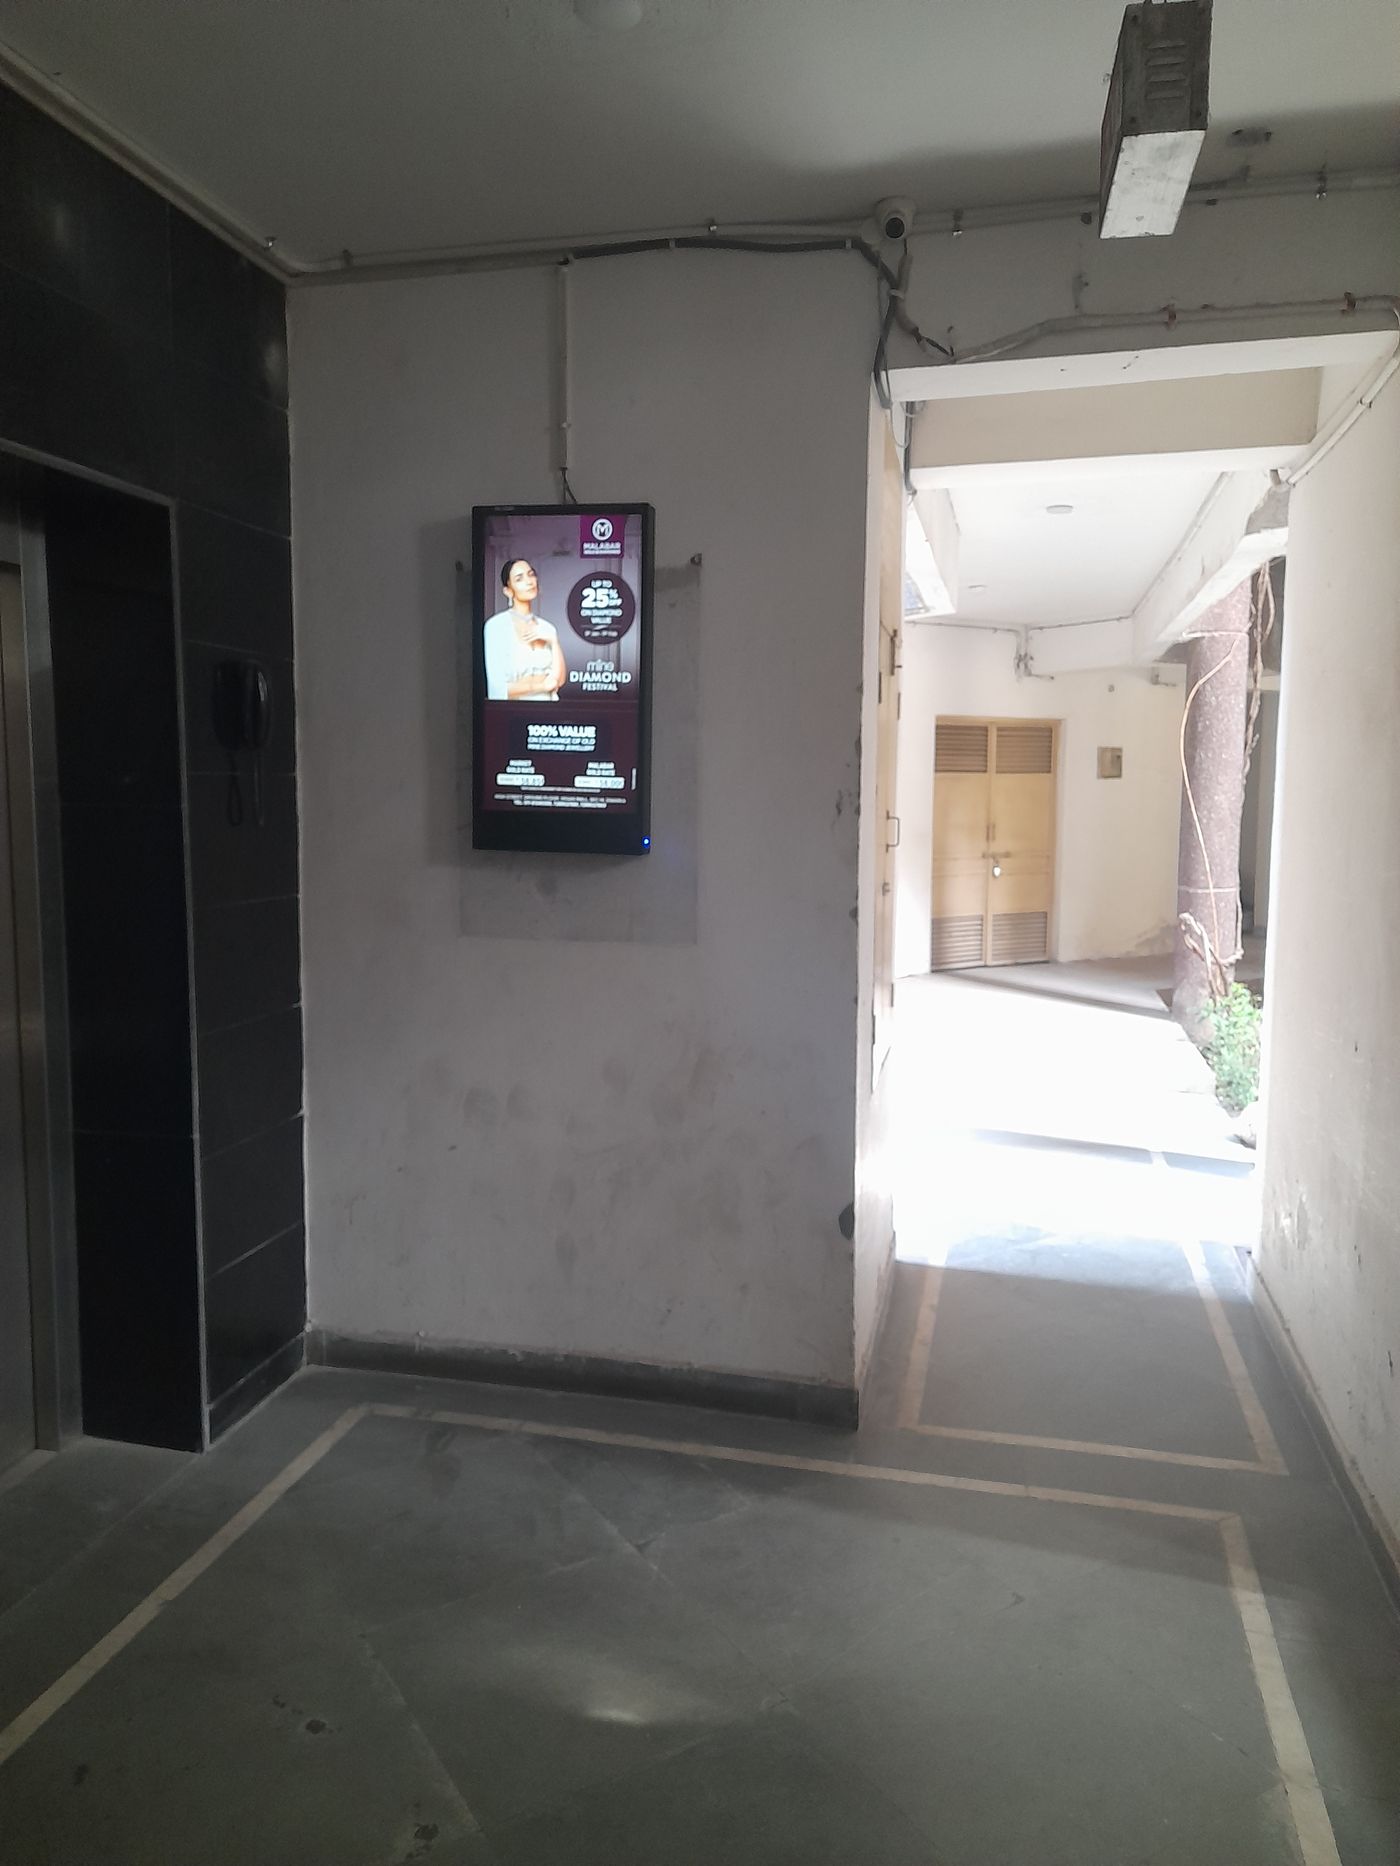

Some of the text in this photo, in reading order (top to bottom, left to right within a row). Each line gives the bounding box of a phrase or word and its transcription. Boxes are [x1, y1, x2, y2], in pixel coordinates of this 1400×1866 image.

[569, 671, 632, 683] DIAMOND
[582, 682, 618, 691] FESTIVAL
[527, 724, 596, 737] 100% VALUE
